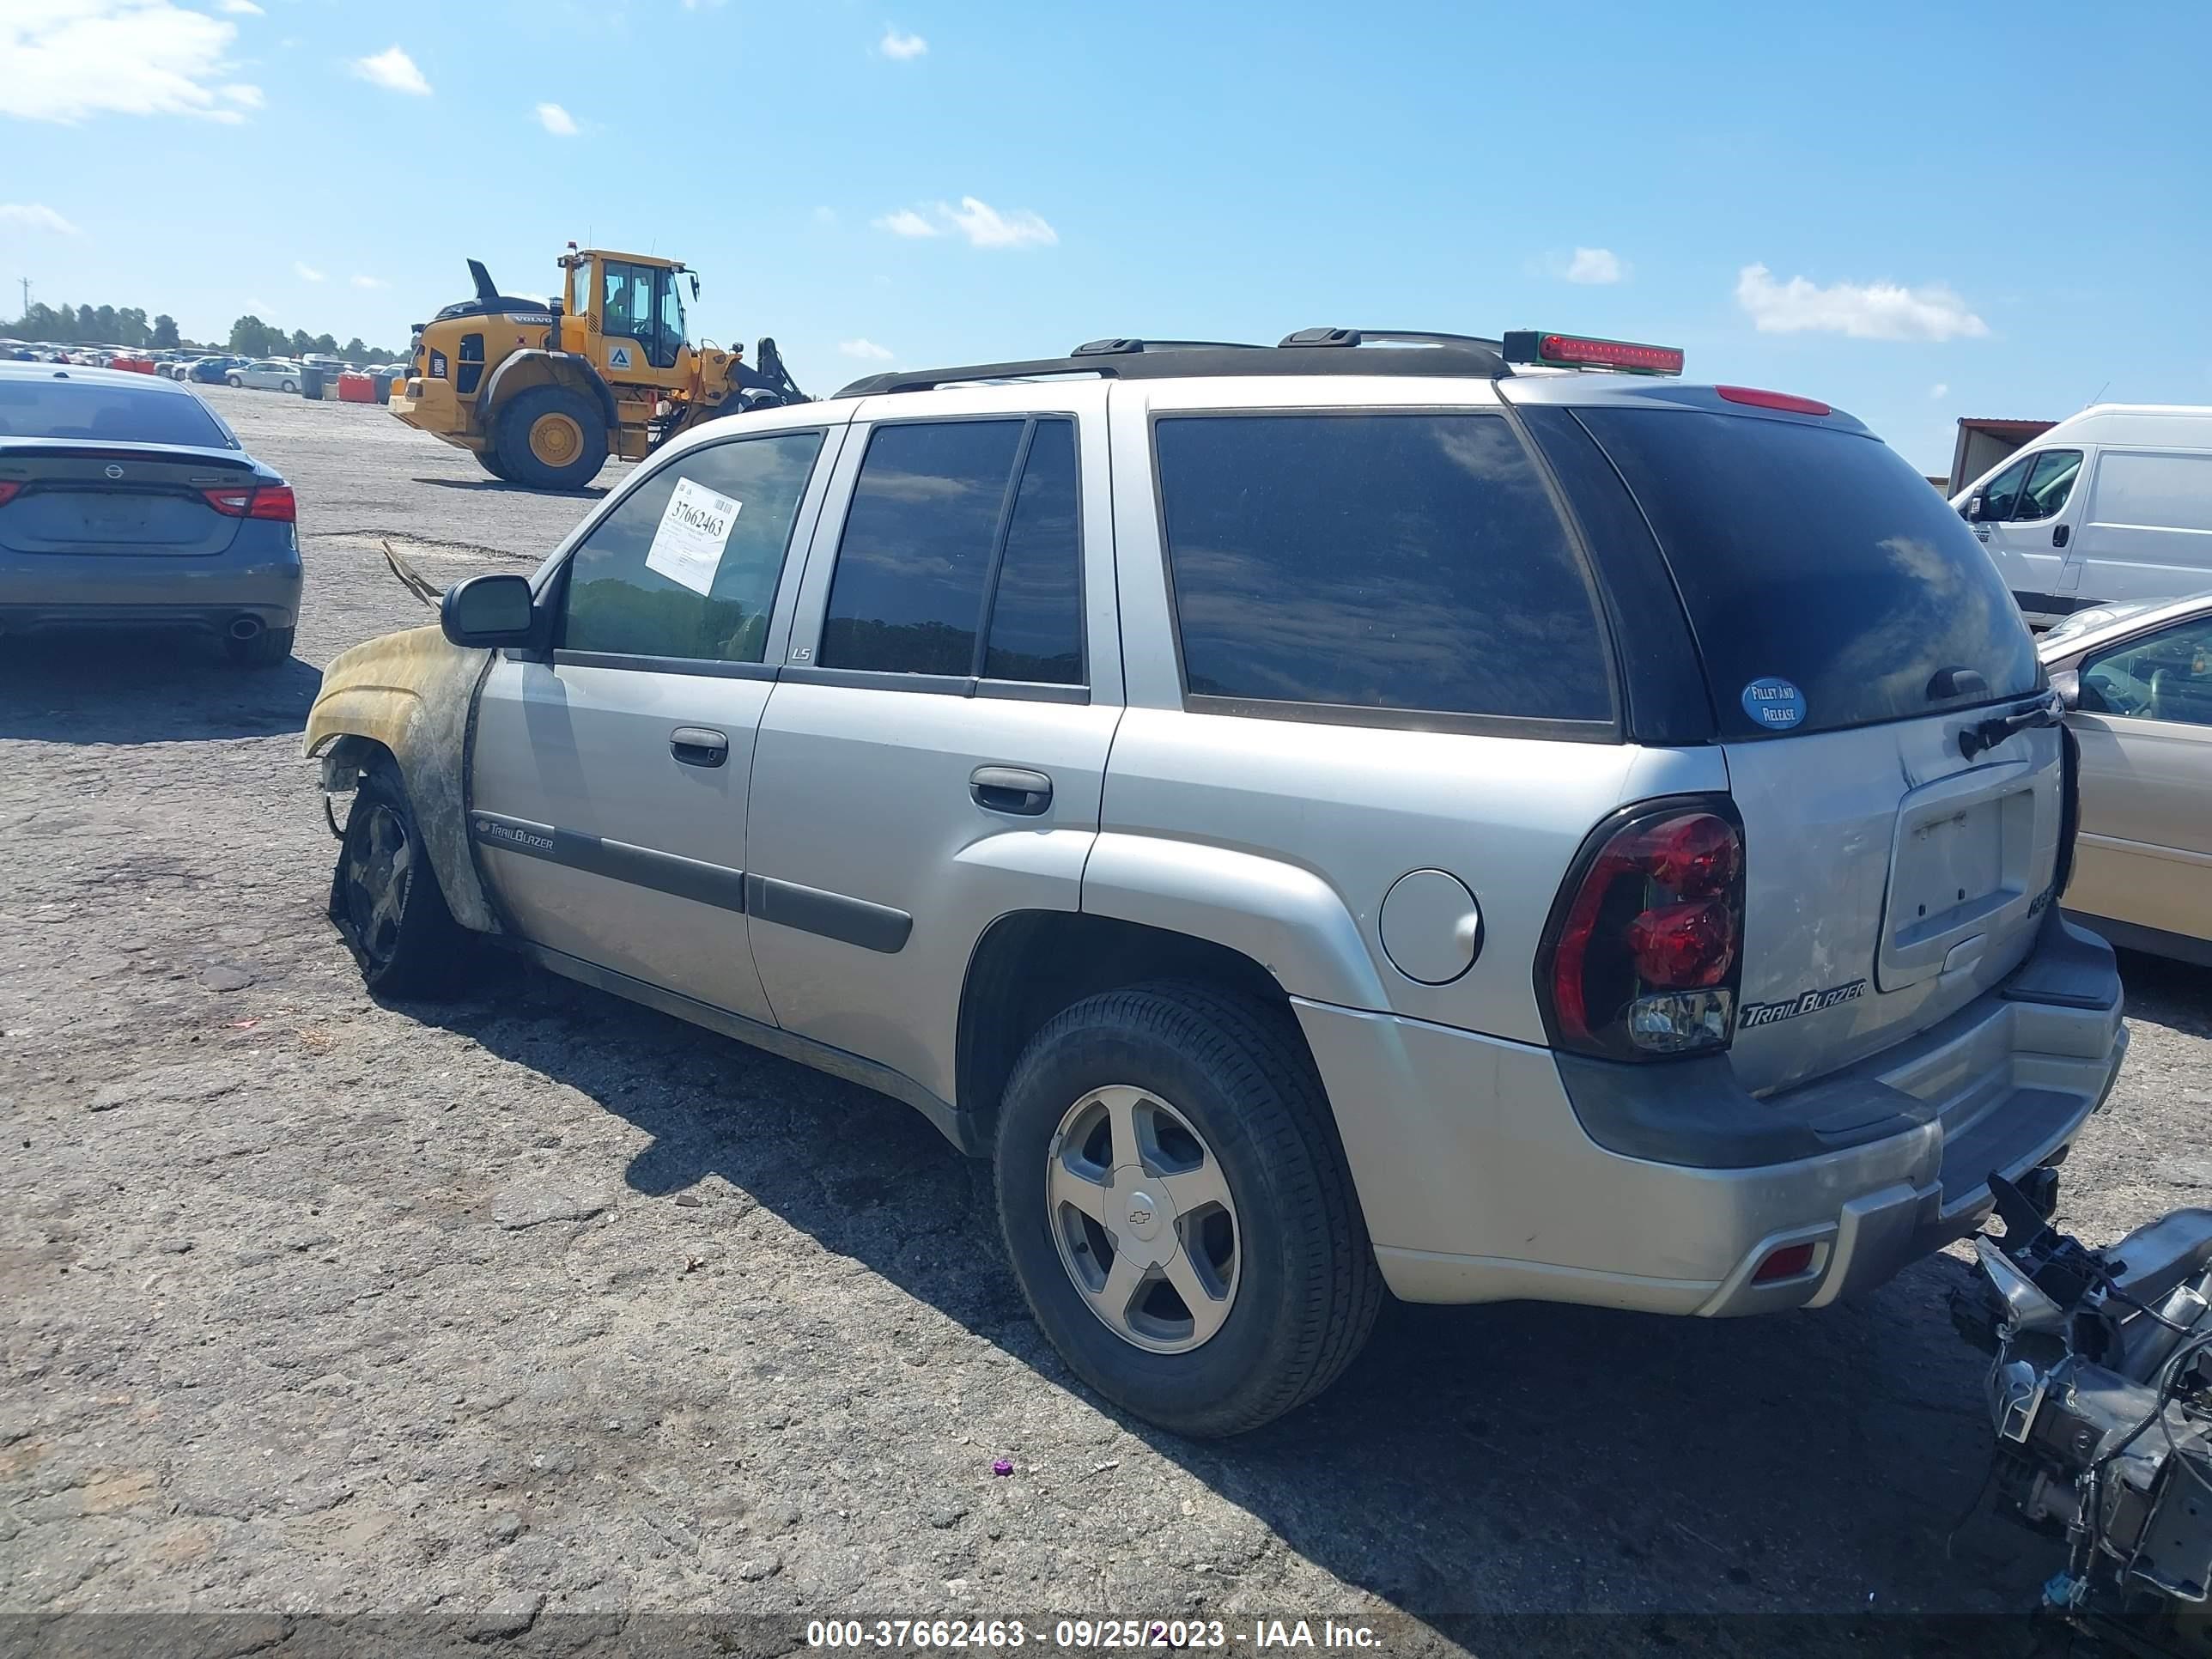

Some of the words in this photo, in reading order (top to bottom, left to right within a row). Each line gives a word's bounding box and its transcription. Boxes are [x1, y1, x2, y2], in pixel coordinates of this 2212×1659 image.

[434, 358, 445, 376] L90H
[672, 501, 724, 537] 37662463
[792, 647, 811, 659] LS
[1778, 685, 1795, 699] AND
[1762, 707, 1796, 721] RELEASE
